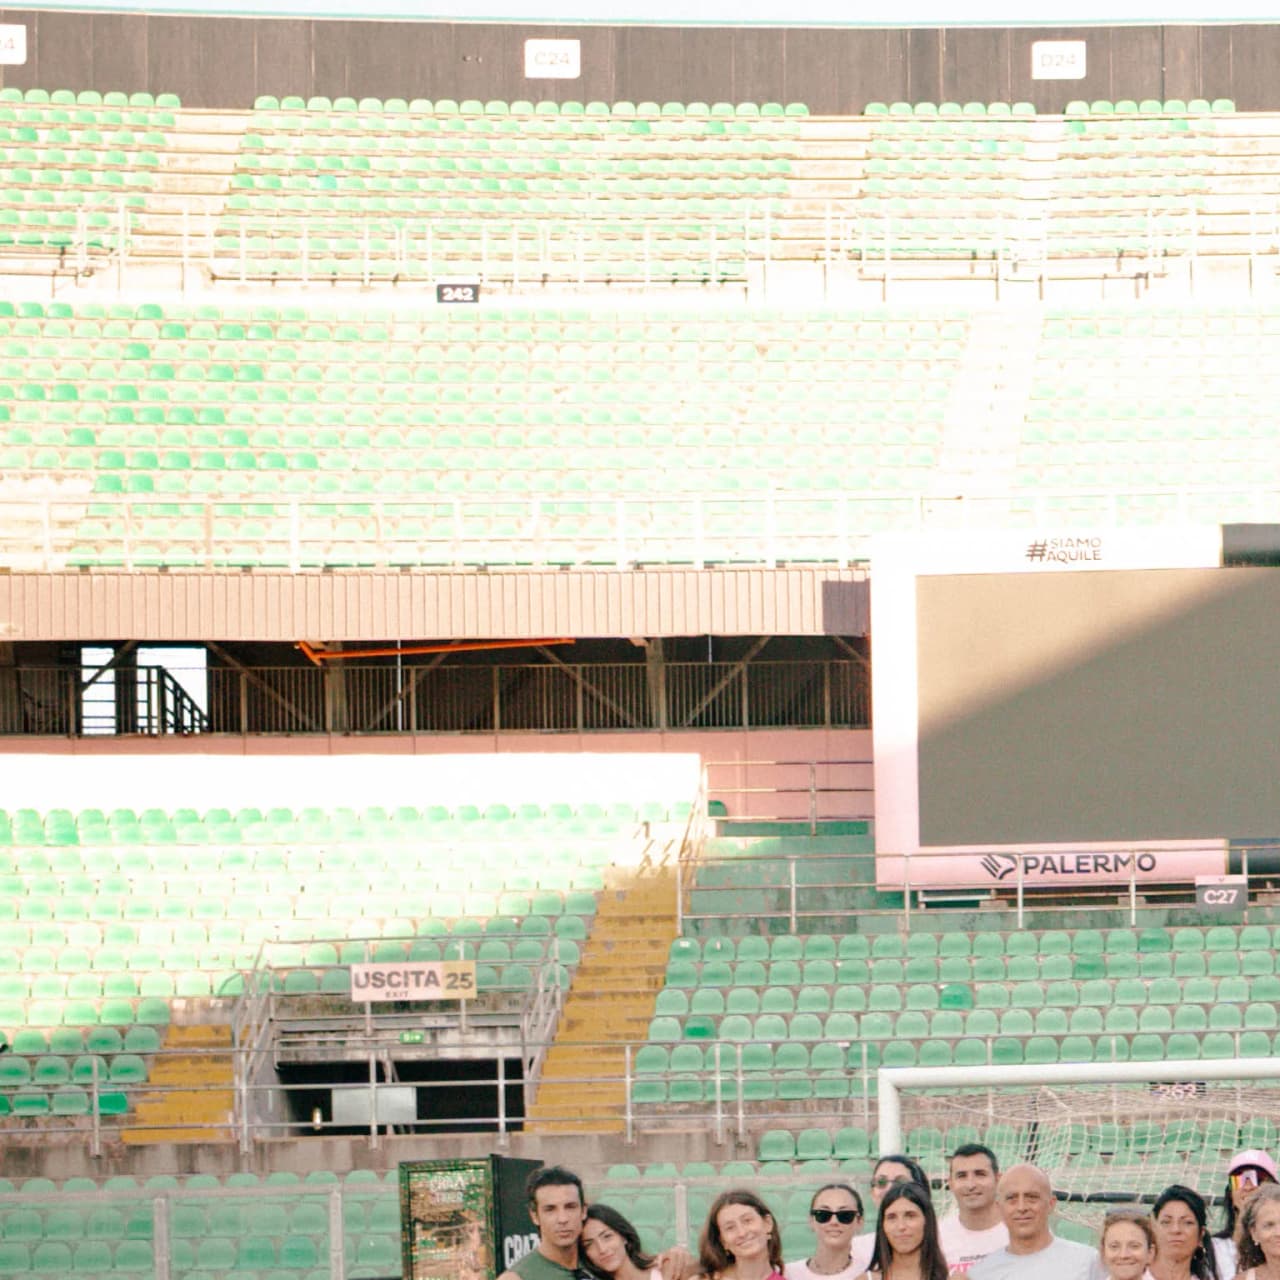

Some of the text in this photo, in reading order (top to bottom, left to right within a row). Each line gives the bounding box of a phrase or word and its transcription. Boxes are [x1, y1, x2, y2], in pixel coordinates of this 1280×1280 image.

[534, 51, 571, 66] C24
[442, 287, 474, 301] 242
[1046, 549, 1102, 563] AQUILE
[1023, 853, 1156, 875] PALERMO
[1204, 889, 1238, 904] C27
[353, 970, 474, 990] USCITA 25
[385, 991, 411, 999] EXIT
[504, 1233, 540, 1269] CRAZ
